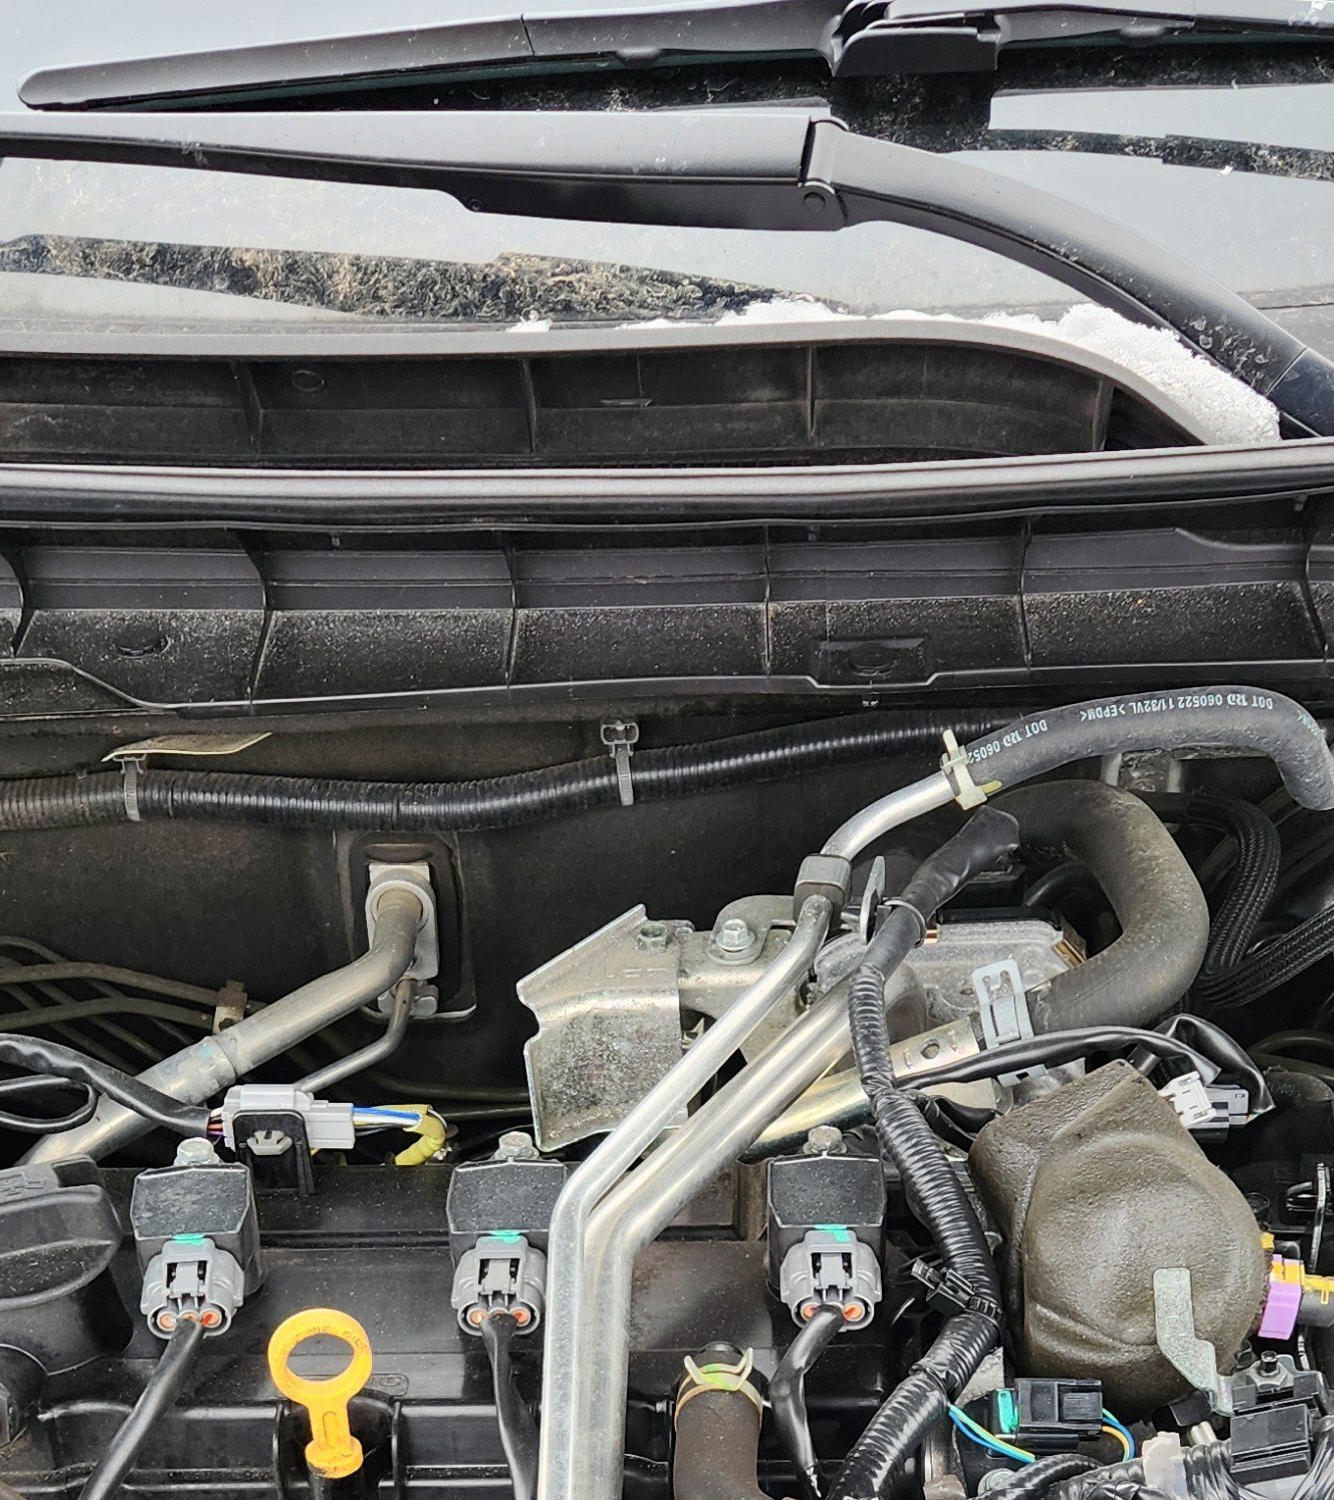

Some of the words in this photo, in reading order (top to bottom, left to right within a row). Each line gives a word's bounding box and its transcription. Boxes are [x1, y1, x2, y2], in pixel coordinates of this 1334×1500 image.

[1178, 694, 1222, 709] 060522
[1252, 696, 1273, 709] DOT
[1025, 719, 1047, 738] DOT
[967, 740, 1001, 764] 06052
